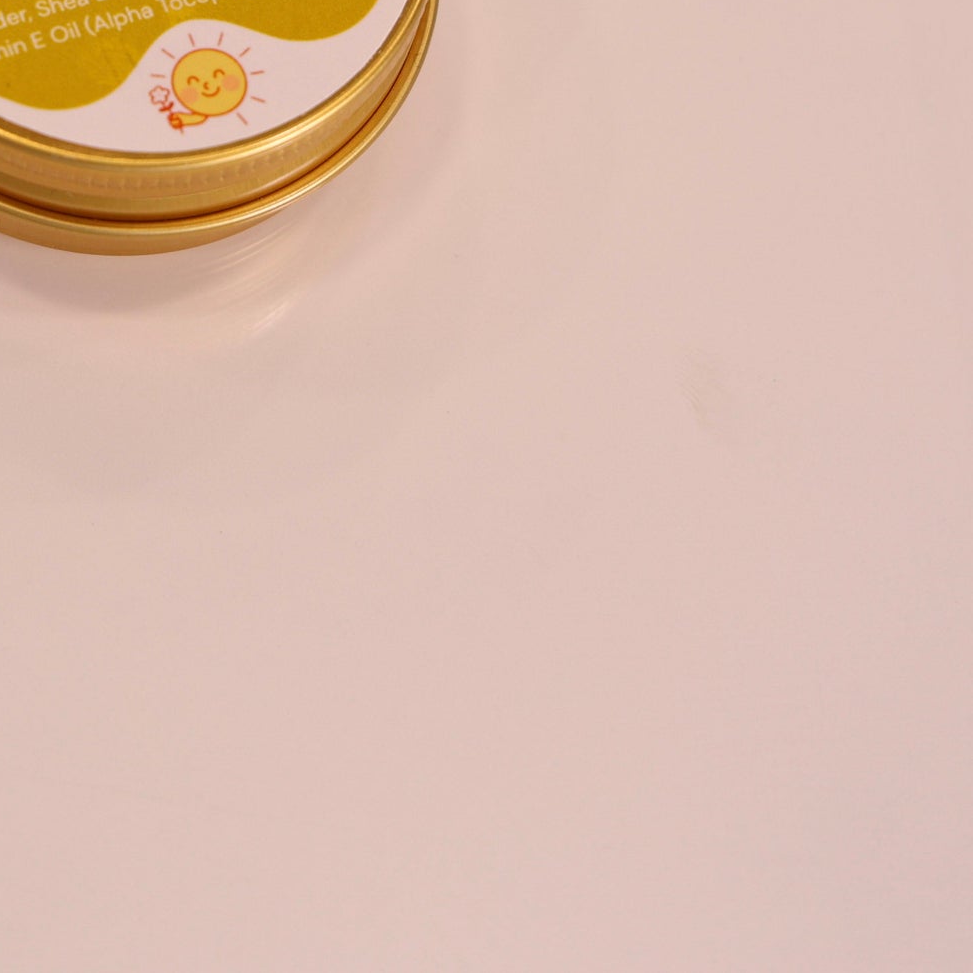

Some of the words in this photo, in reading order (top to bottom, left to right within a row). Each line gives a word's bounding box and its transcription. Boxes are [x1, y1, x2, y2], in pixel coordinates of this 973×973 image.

[29, 30, 47, 50] E
[50, 23, 82, 43] Oil
[83, 2, 154, 36] (Alpha
